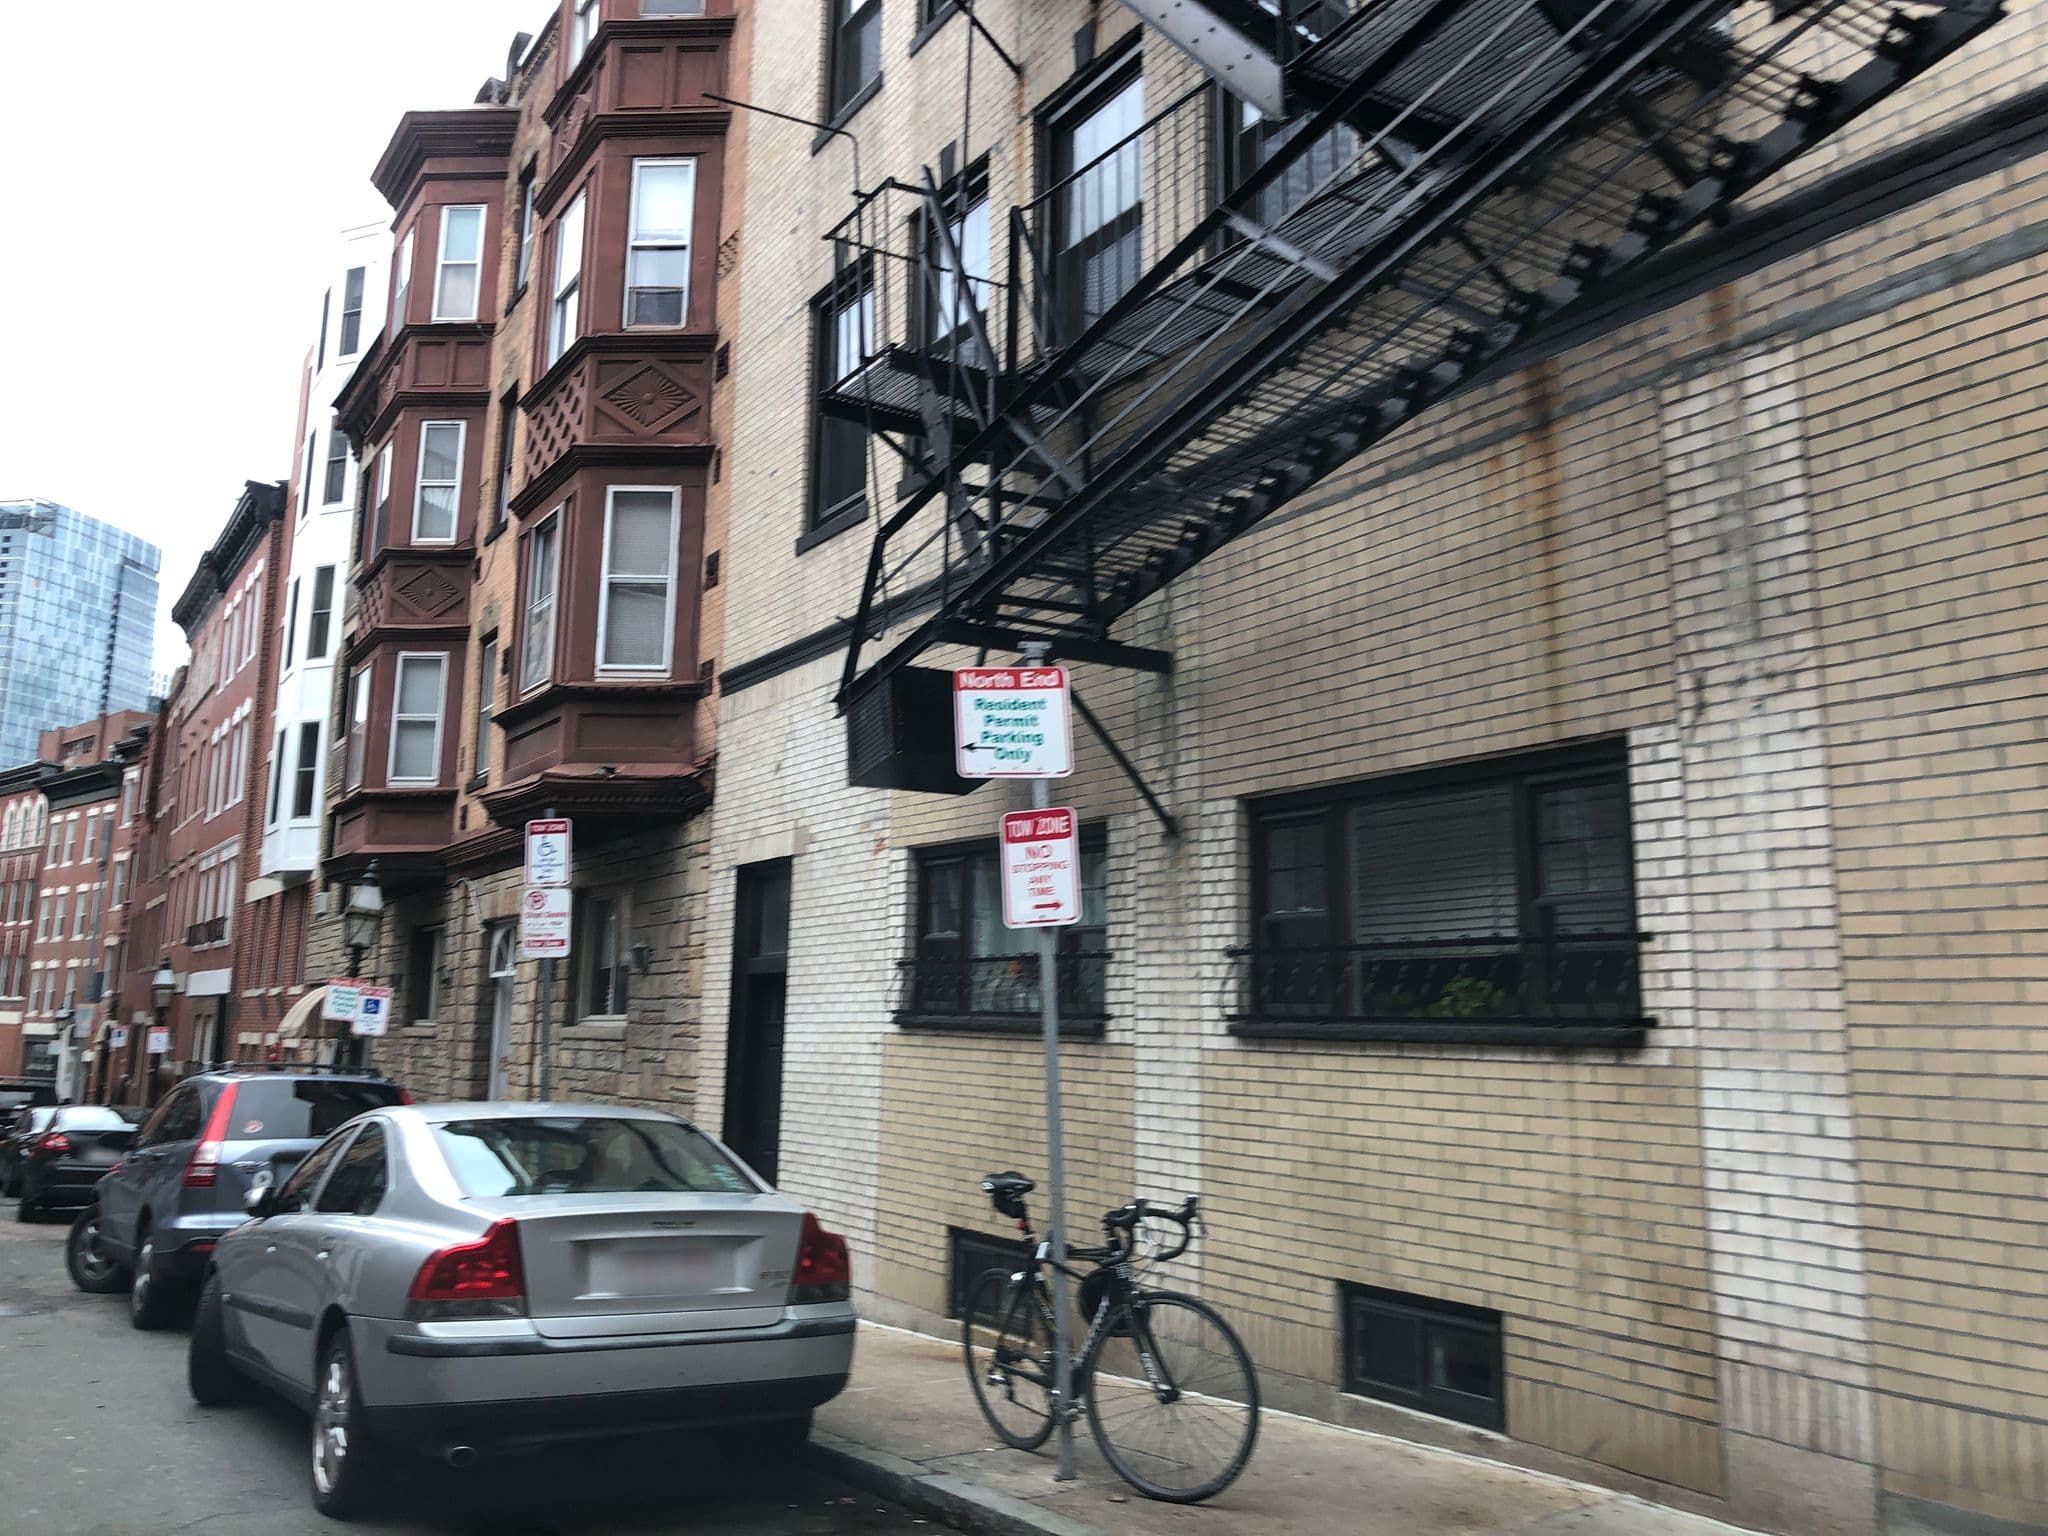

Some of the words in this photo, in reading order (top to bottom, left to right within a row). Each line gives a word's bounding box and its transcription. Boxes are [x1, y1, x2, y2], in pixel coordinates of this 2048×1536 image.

[959, 672, 1015, 688] North
[1020, 671, 1060, 688] End
[975, 698, 1047, 711] Resident
[984, 715, 1039, 727] Permit
[981, 731, 1044, 746] Parking
[995, 747, 1032, 763] Only
[1007, 820, 1034, 838] TOW
[1035, 816, 1070, 836] ZONE
[1025, 844, 1053, 858] NO
[1011, 860, 1069, 874] STOPPING
[1029, 875, 1052, 884] ANY
[1028, 886, 1055, 896] TIME
